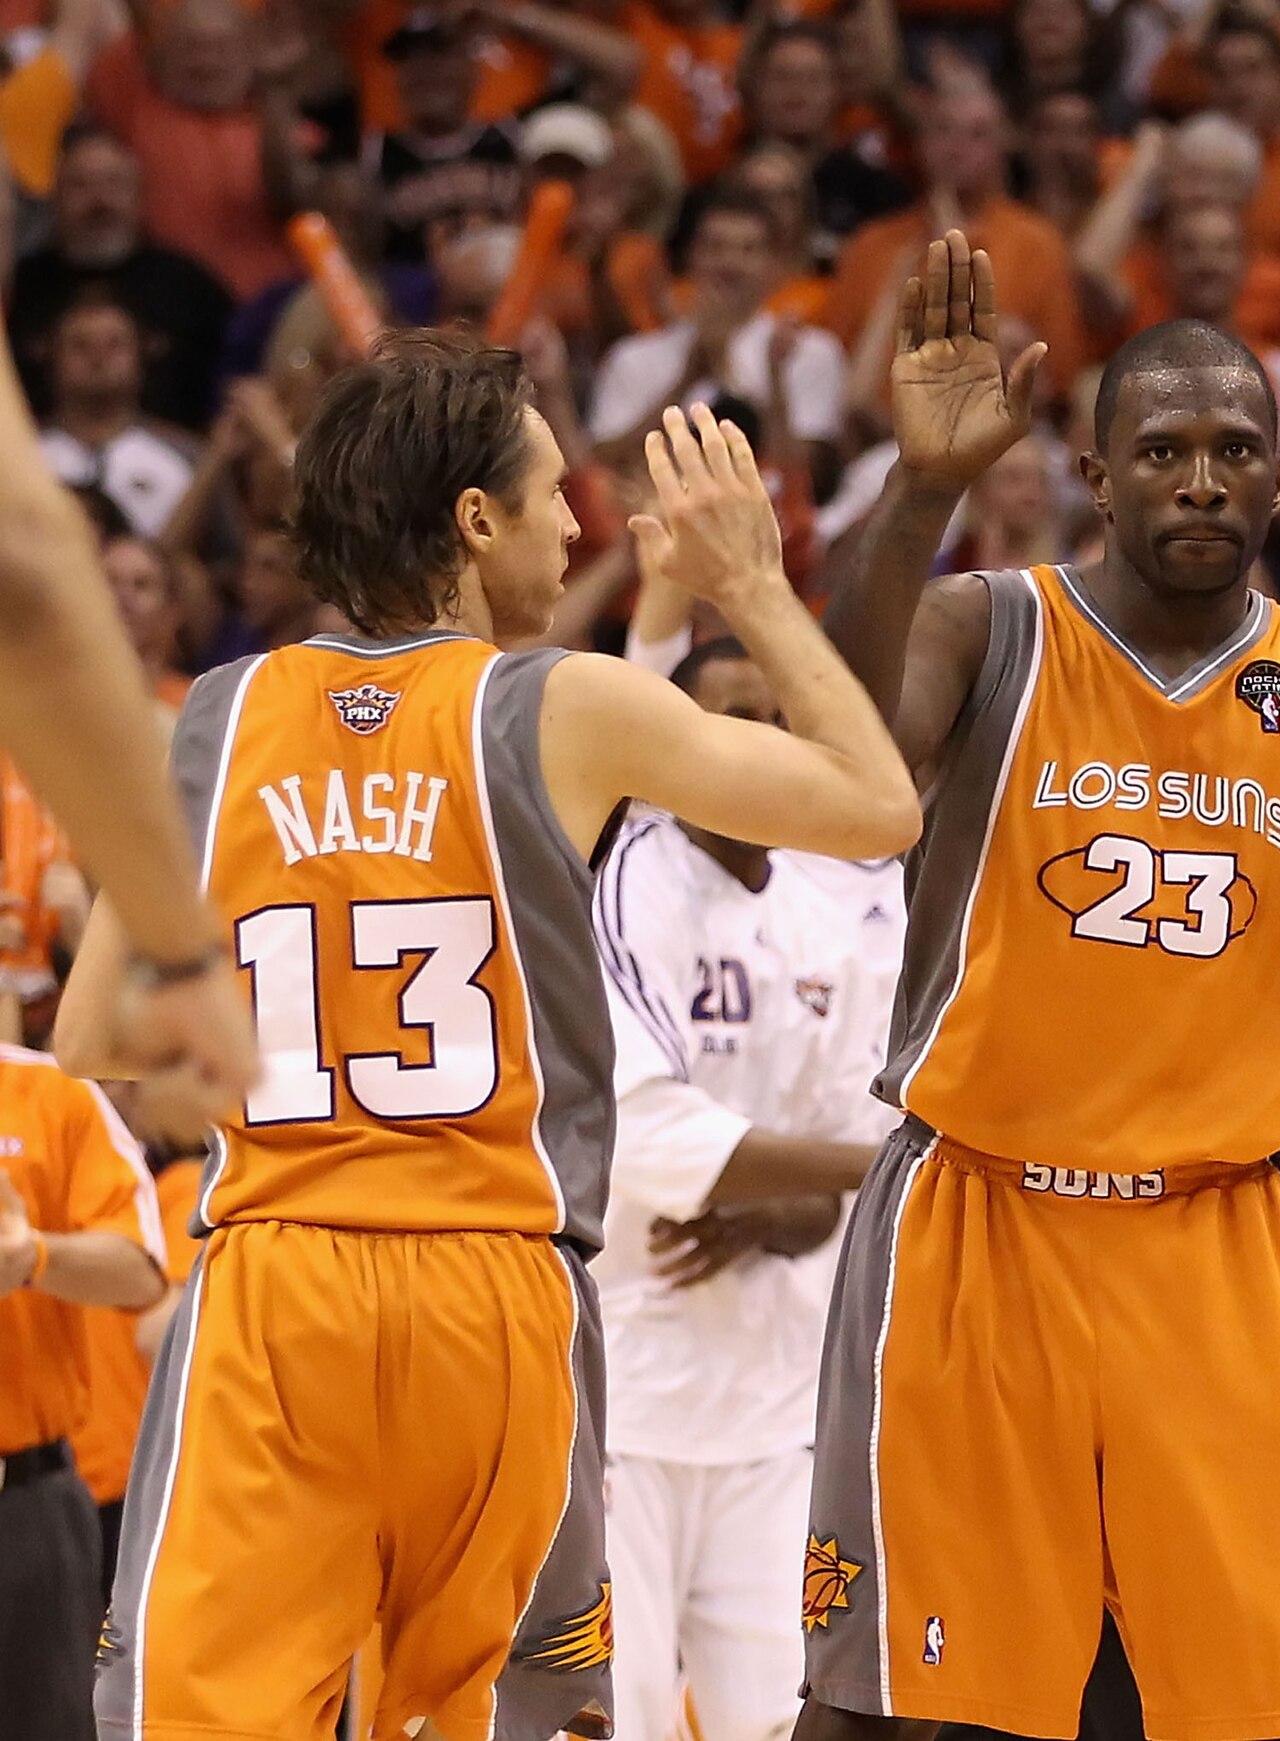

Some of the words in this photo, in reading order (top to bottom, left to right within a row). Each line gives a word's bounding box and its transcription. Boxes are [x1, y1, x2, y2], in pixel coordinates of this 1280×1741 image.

[346, 705, 382, 720] PHX
[258, 769, 448, 866] NASH
[1032, 761, 1151, 811] LOS
[1071, 832, 1238, 959] 23
[234, 895, 499, 1128] 13
[691, 956, 750, 1022] 20
